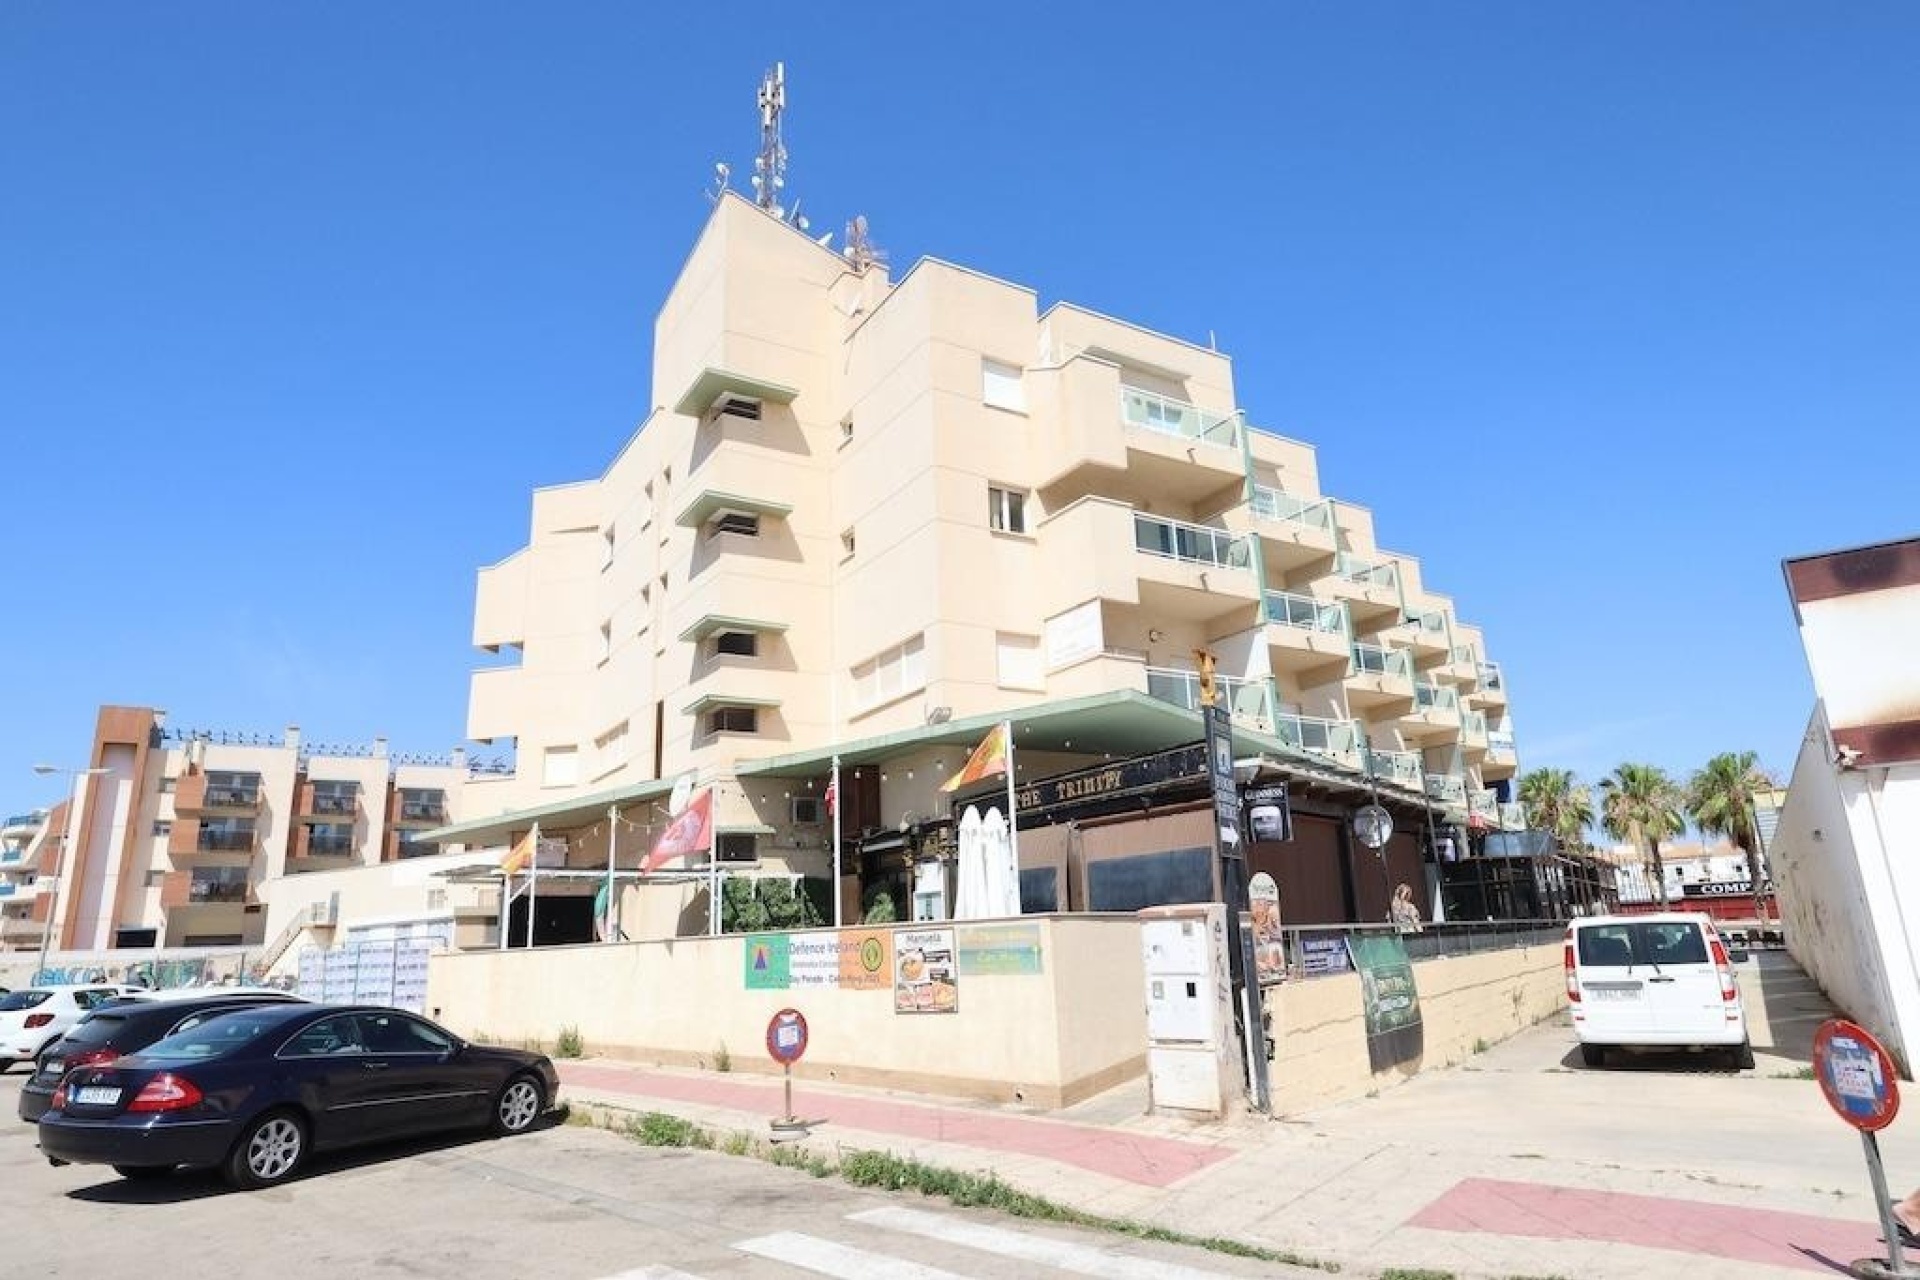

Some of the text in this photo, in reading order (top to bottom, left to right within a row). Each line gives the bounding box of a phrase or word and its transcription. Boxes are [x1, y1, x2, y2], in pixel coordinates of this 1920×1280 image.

[1056, 769, 1122, 799] TRINITY
[788, 941, 824, 955] Defence
[827, 940, 860, 954] Ireland
